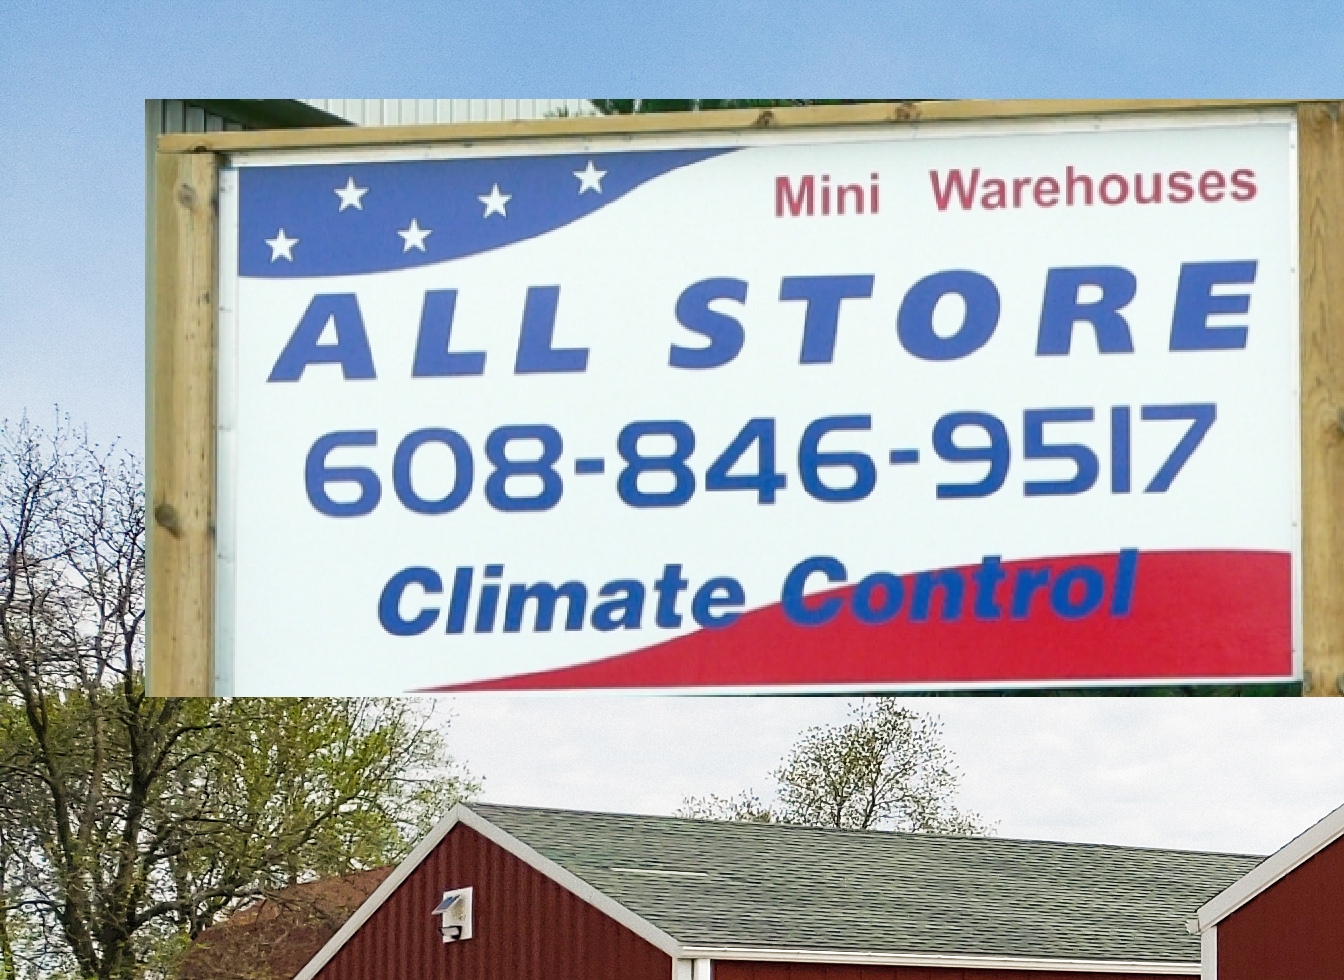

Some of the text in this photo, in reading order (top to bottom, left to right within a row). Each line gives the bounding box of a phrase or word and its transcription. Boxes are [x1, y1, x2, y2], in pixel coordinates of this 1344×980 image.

[776, 165, 1257, 217] Mini Warehouses
[268, 260, 1257, 383] ALL STORE
[304, 403, 1217, 517] 608-846-9517
[377, 548, 1139, 637] Climate Control
